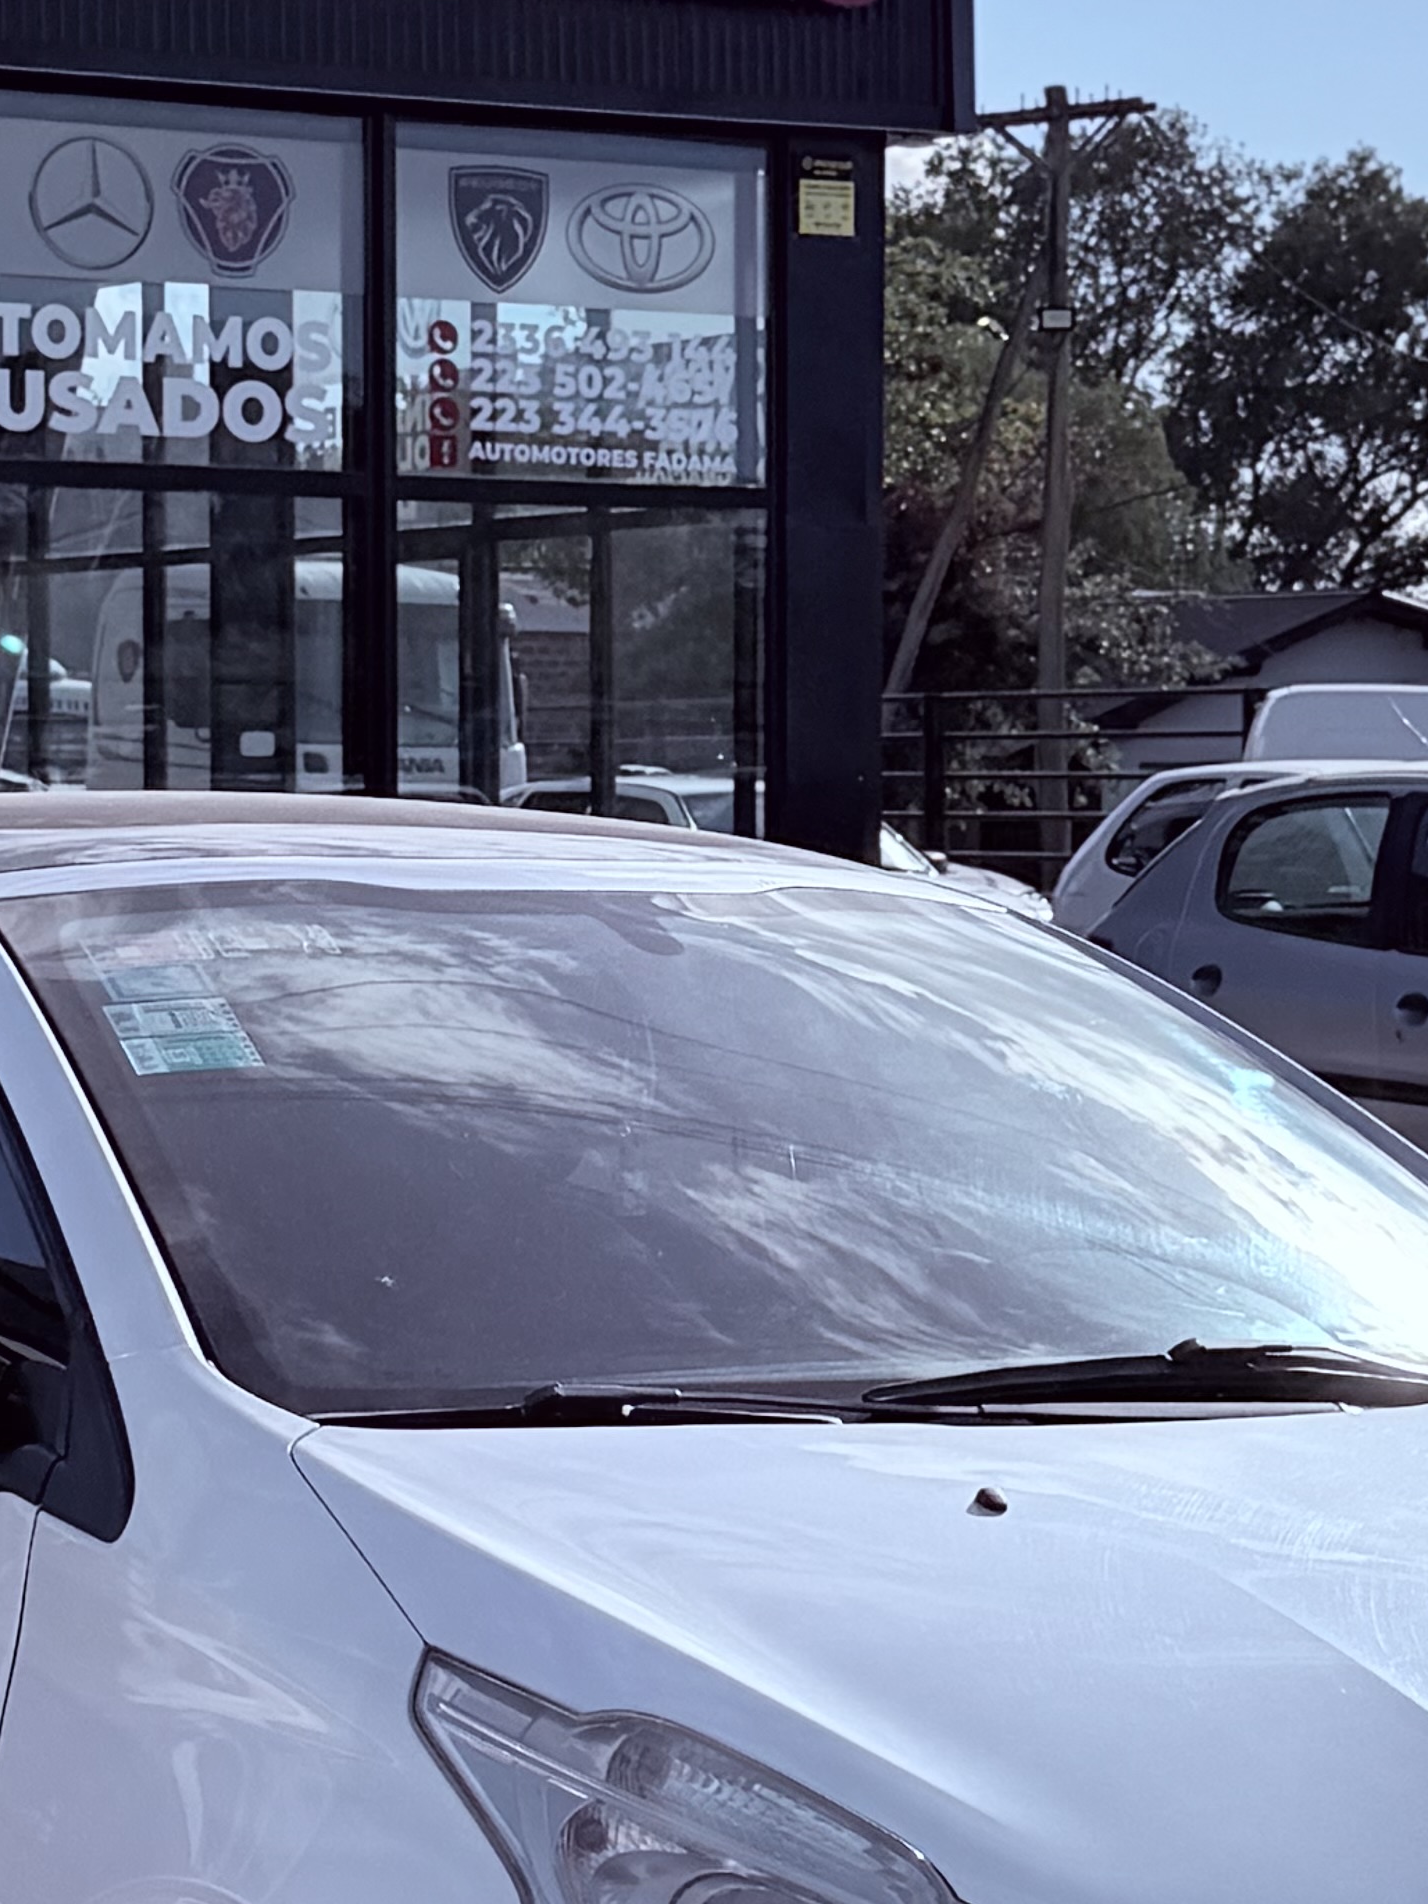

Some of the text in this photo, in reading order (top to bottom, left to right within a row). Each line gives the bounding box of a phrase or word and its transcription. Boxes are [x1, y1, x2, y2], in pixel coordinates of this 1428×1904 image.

[469, 397, 542, 434] 223
[468, 441, 738, 474] AUTOMOTORES FADAMA
